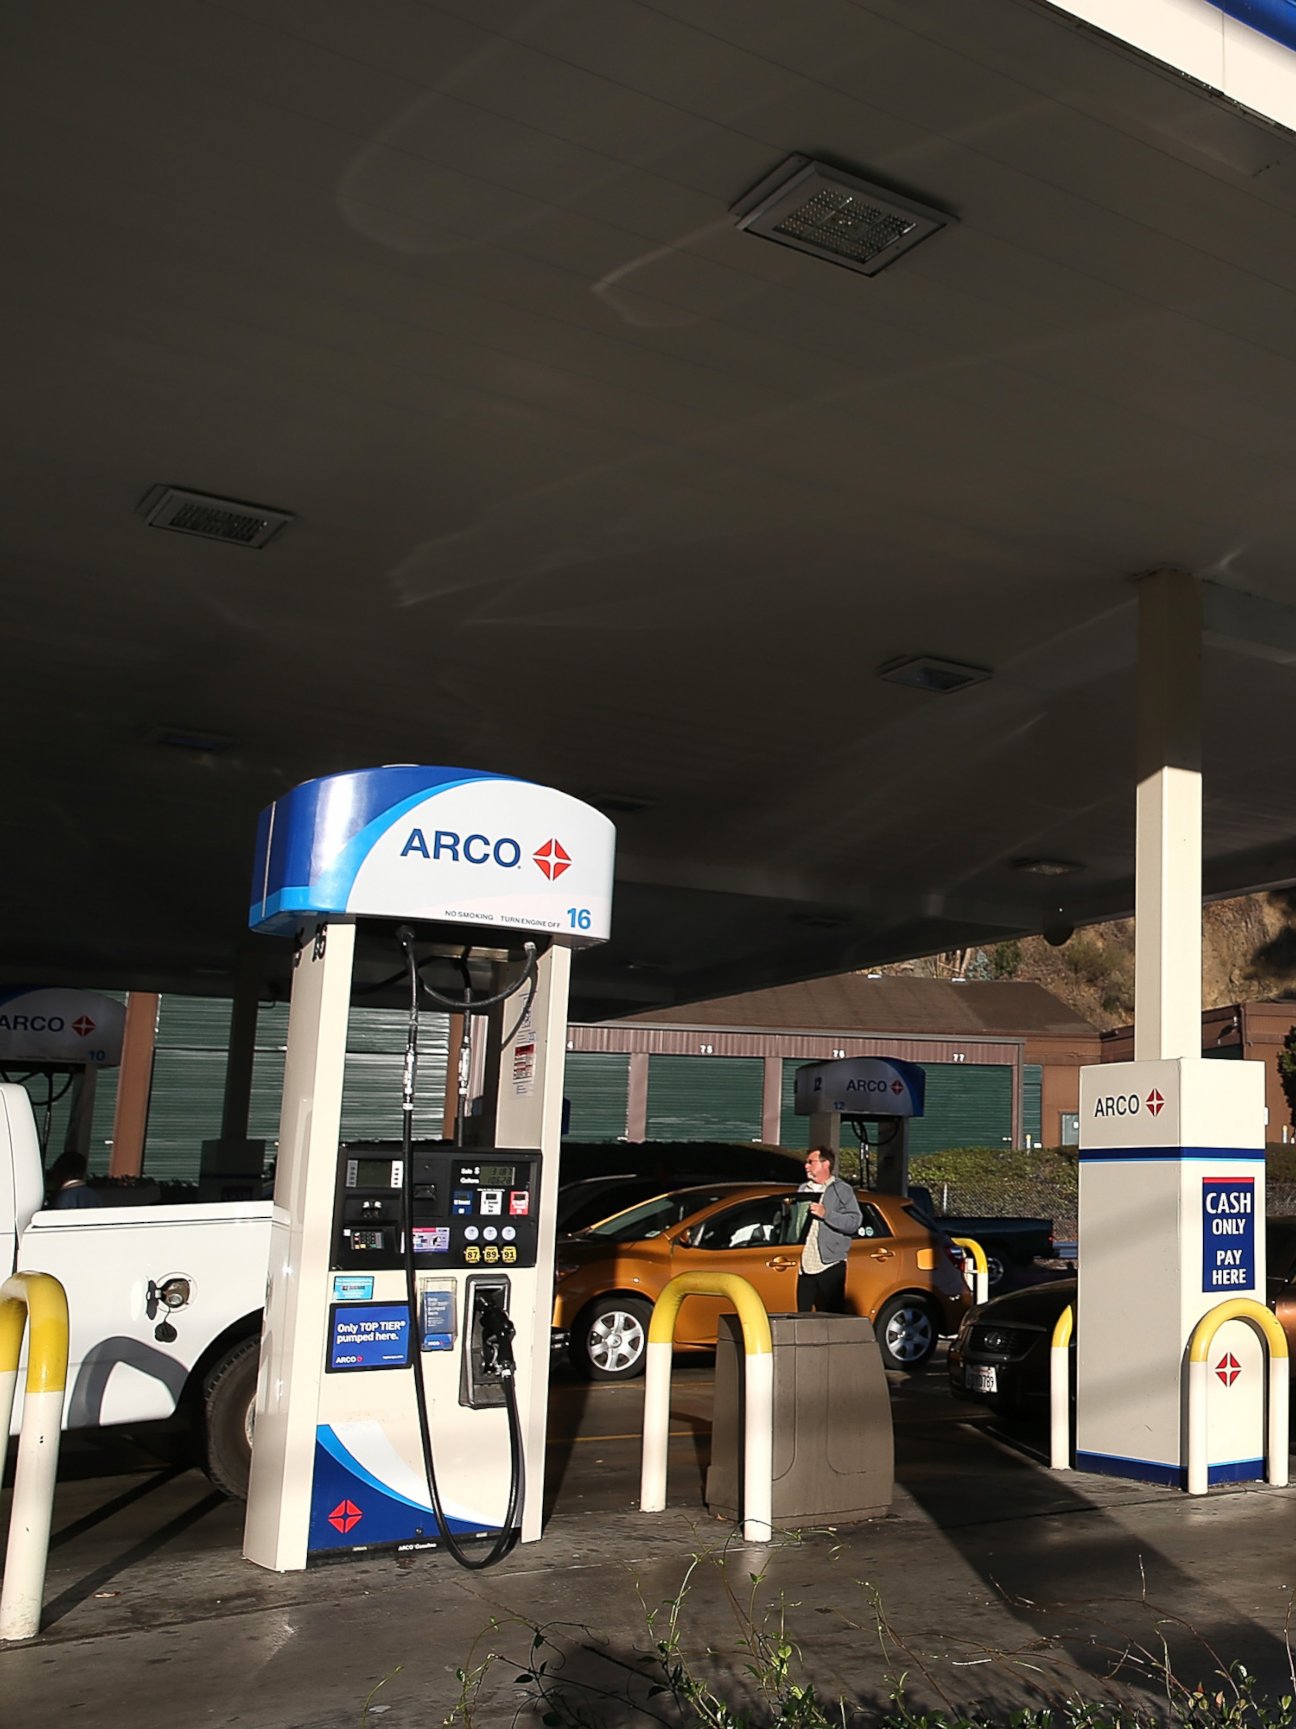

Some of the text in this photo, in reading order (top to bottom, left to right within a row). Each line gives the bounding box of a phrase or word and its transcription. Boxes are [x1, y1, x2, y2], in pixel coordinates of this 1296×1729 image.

[400, 828, 521, 868] ARCO
[458, 911, 494, 921] SMOKING
[567, 908, 592, 930] 16
[0, 1014, 65, 1032] ARCO
[89, 1049, 105, 1061] 10
[953, 1053, 966, 1062] 77
[846, 1080, 887, 1092] ARCO
[1094, 1095, 1140, 1118] ARCO
[1206, 1192, 1252, 1214] CASH
[1212, 1218, 1246, 1235] ONLY
[467, 1251, 478, 1259] 87
[486, 1251, 497, 1259] 89
[504, 1250, 515, 1259] 91
[1216, 1249, 1243, 1266] PAY
[1212, 1269, 1247, 1285] HERE
[337, 1323, 358, 1333] Only
[360, 1322, 379, 1331] TOP
[337, 1331, 399, 1344] pumped here.
